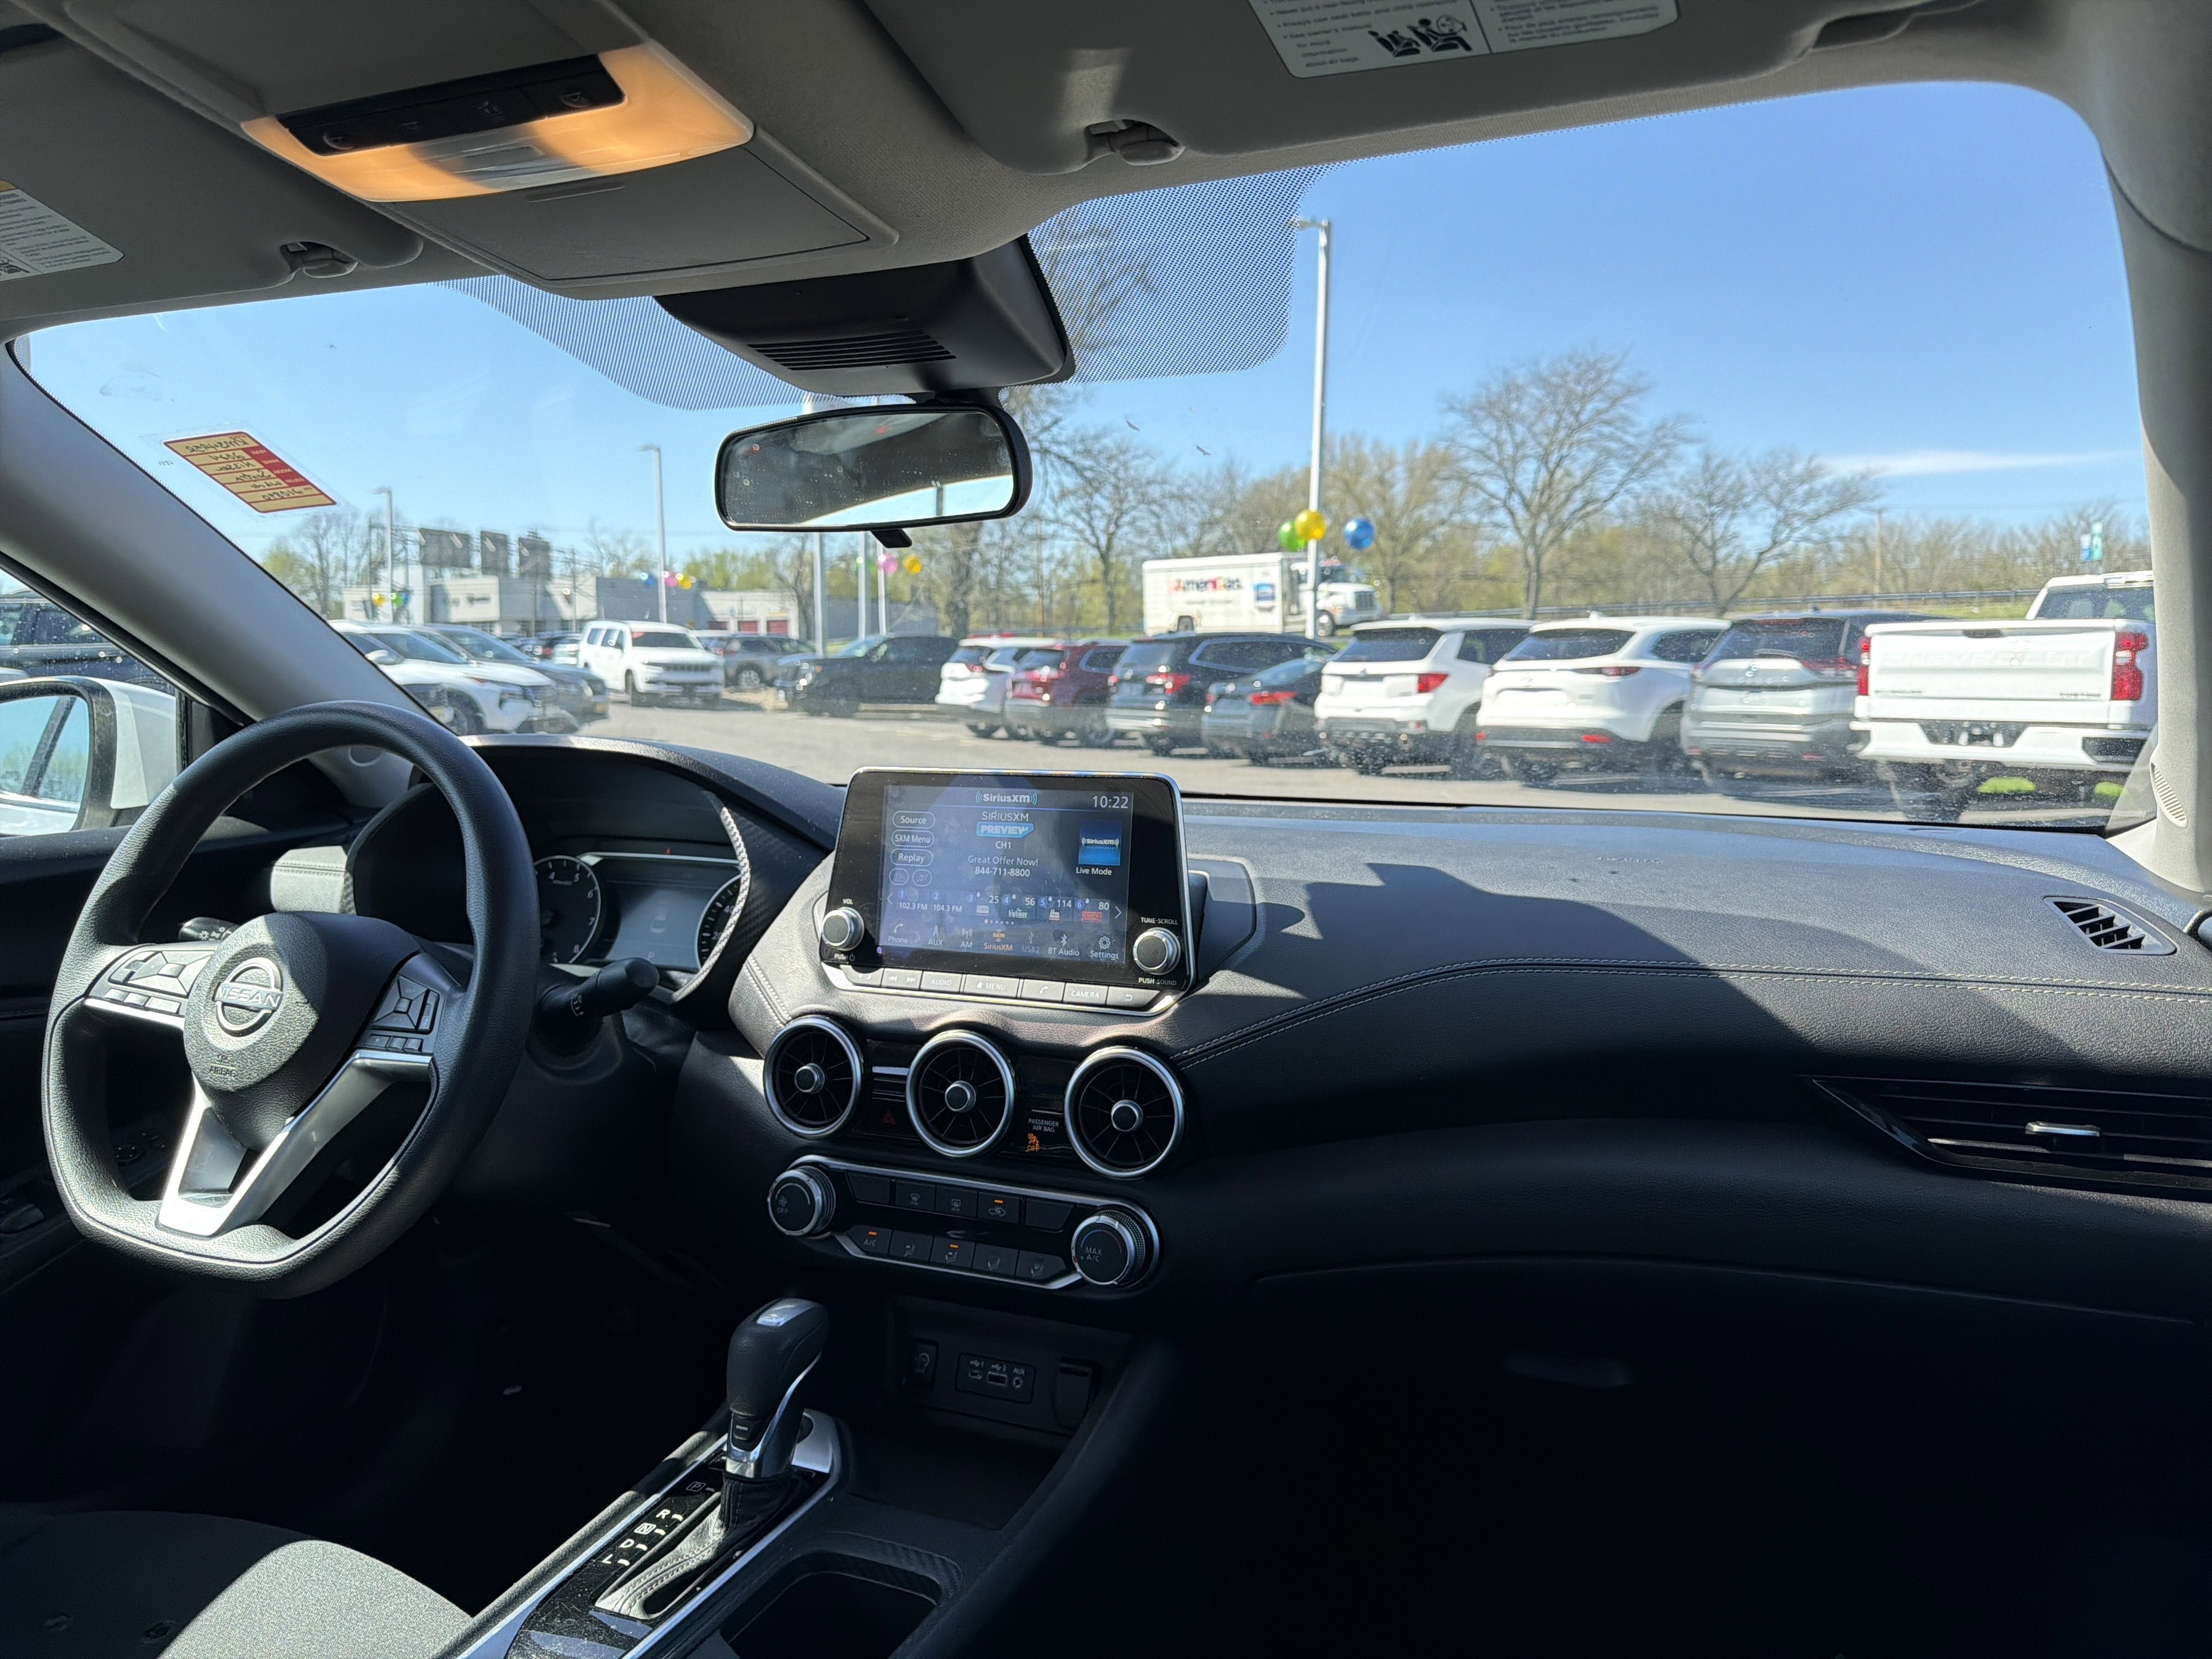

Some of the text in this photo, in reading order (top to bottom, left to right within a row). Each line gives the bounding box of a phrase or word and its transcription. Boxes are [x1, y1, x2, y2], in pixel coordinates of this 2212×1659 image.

[1093, 795, 1128, 809] 10:22
[900, 816, 927, 825] Source
[981, 811, 1029, 822] SIRIUSXM
[980, 825, 1030, 835] PREVIEW
[894, 834, 930, 844] SXM Menu
[995, 841, 1011, 849] CH1
[898, 854, 925, 864] Replay
[968, 855, 1039, 866] Great Offer Now!
[549, 871, 555, 880] 4
[975, 867, 1030, 878] 844-711-8800
[588, 889, 594, 899] 6
[989, 895, 999, 904] 25
[1025, 898, 1035, 906] 56
[1057, 899, 1071, 908] 114
[933, 904, 950, 912] 104.3
[1098, 902, 1109, 911] 80
[588, 917, 595, 926] 7
[888, 935, 909, 944] Phone
[574, 944, 579, 953] 8
[984, 943, 1013, 952] SiriusXM
[1022, 945, 1040, 953] USB2
[1048, 947, 1080, 957] BT Audio
[1090, 950, 1119, 960] Settings
[930, 979, 952, 987] AUDIO
[1156, 978, 1177, 986] SOUND
[985, 983, 1006, 991] MENU
[216, 988, 280, 1008] NISSAN
[1071, 989, 1099, 999] CAMERA
[1028, 1118, 1059, 1127] PASSENGER
[864, 1239, 877, 1247] A/C
[1085, 1246, 1102, 1256] MAX
[656, 1509, 670, 1519] R
[641, 1525, 651, 1533] N
[619, 1538, 635, 1549] D
[602, 1555, 613, 1564] L
